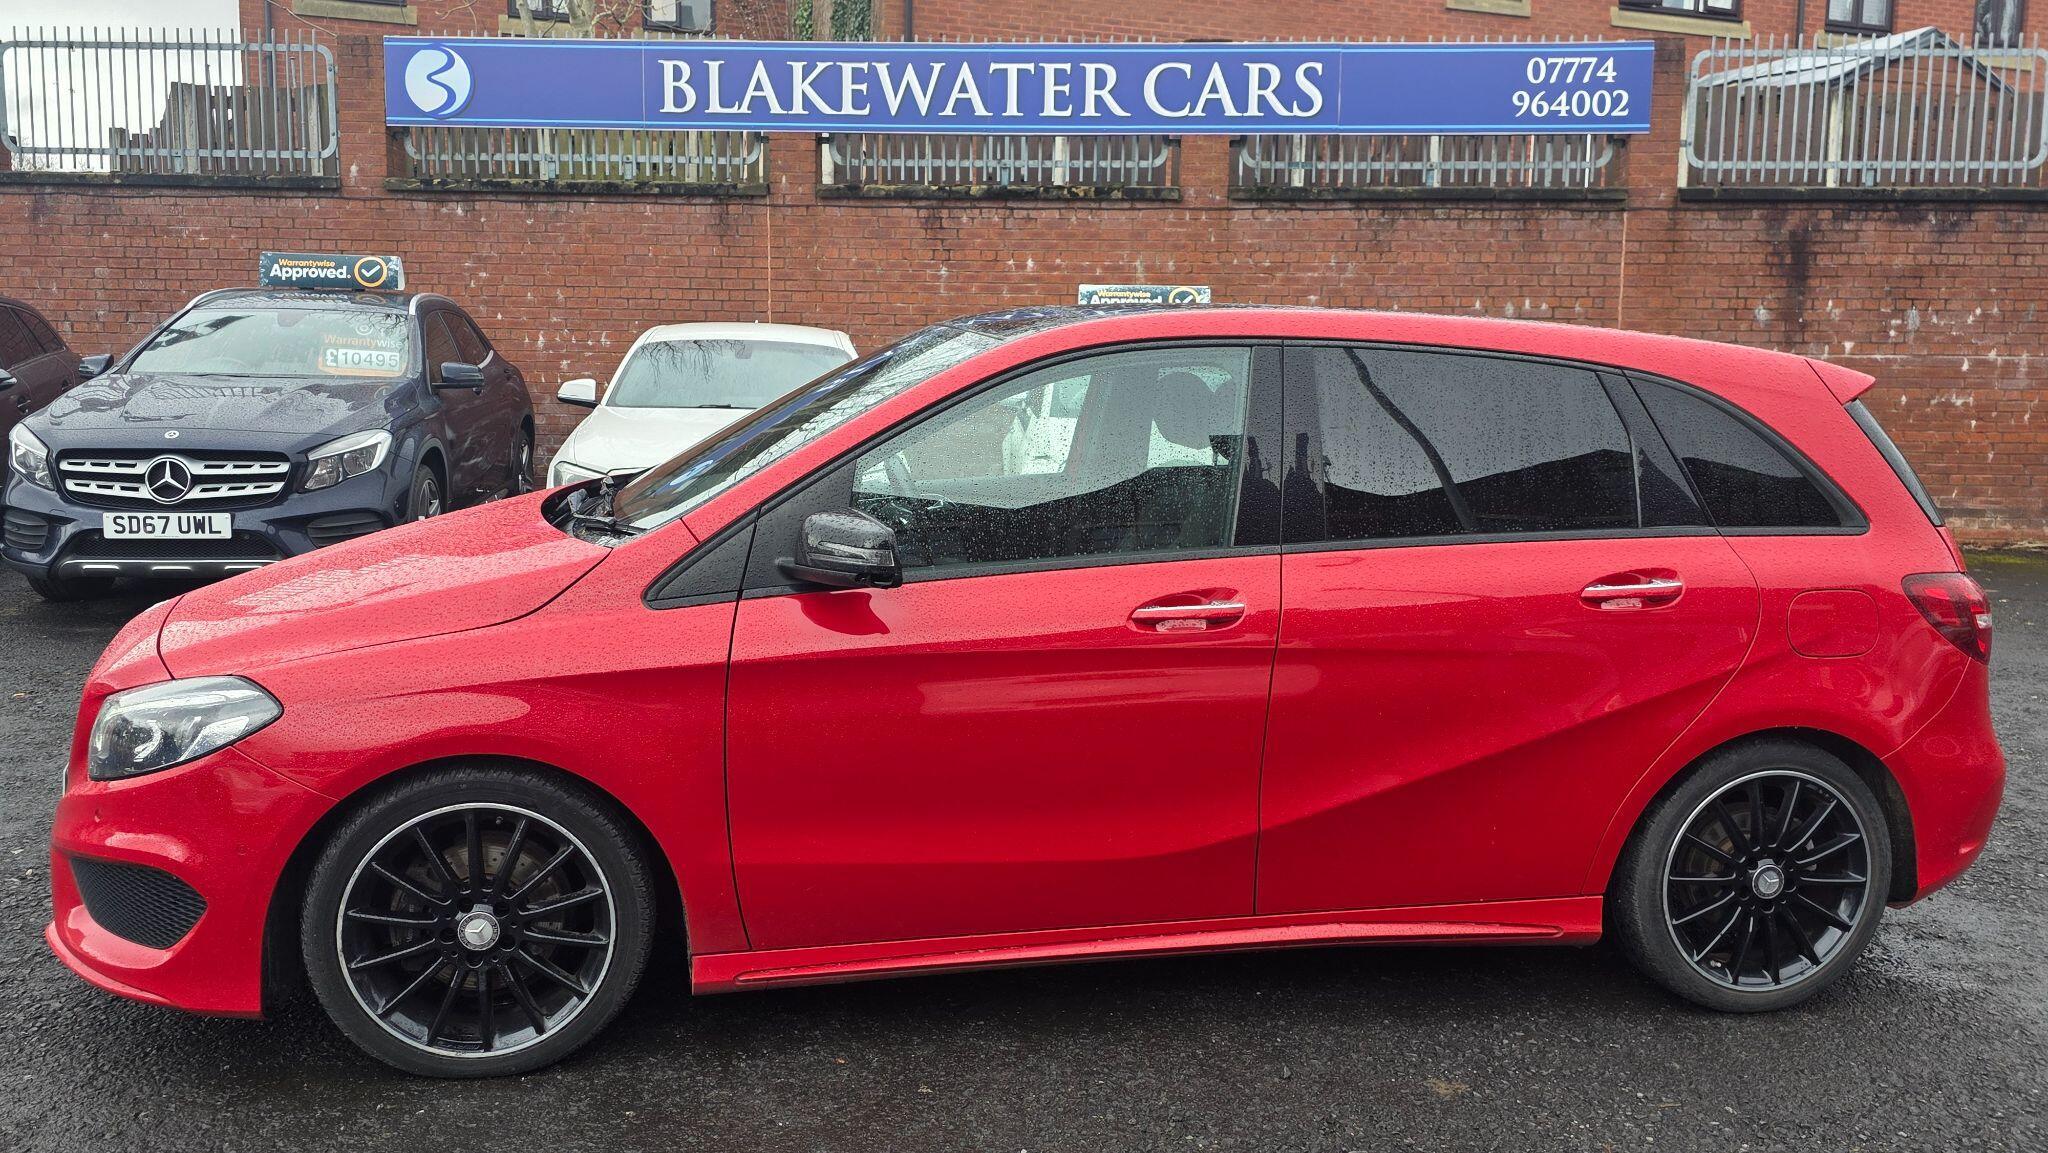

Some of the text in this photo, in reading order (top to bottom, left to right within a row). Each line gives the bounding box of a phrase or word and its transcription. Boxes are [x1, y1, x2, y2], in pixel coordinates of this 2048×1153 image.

[1526, 56, 1618, 84] 07774
[657, 58, 1324, 118] BLAKEWATER CARS
[1511, 89, 1630, 118] 964002
[278, 258, 336, 268] Warrantywise
[323, 333, 404, 349] Warrantywise
[325, 348, 400, 368] £10495
[112, 515, 222, 535] SD67 UWL
